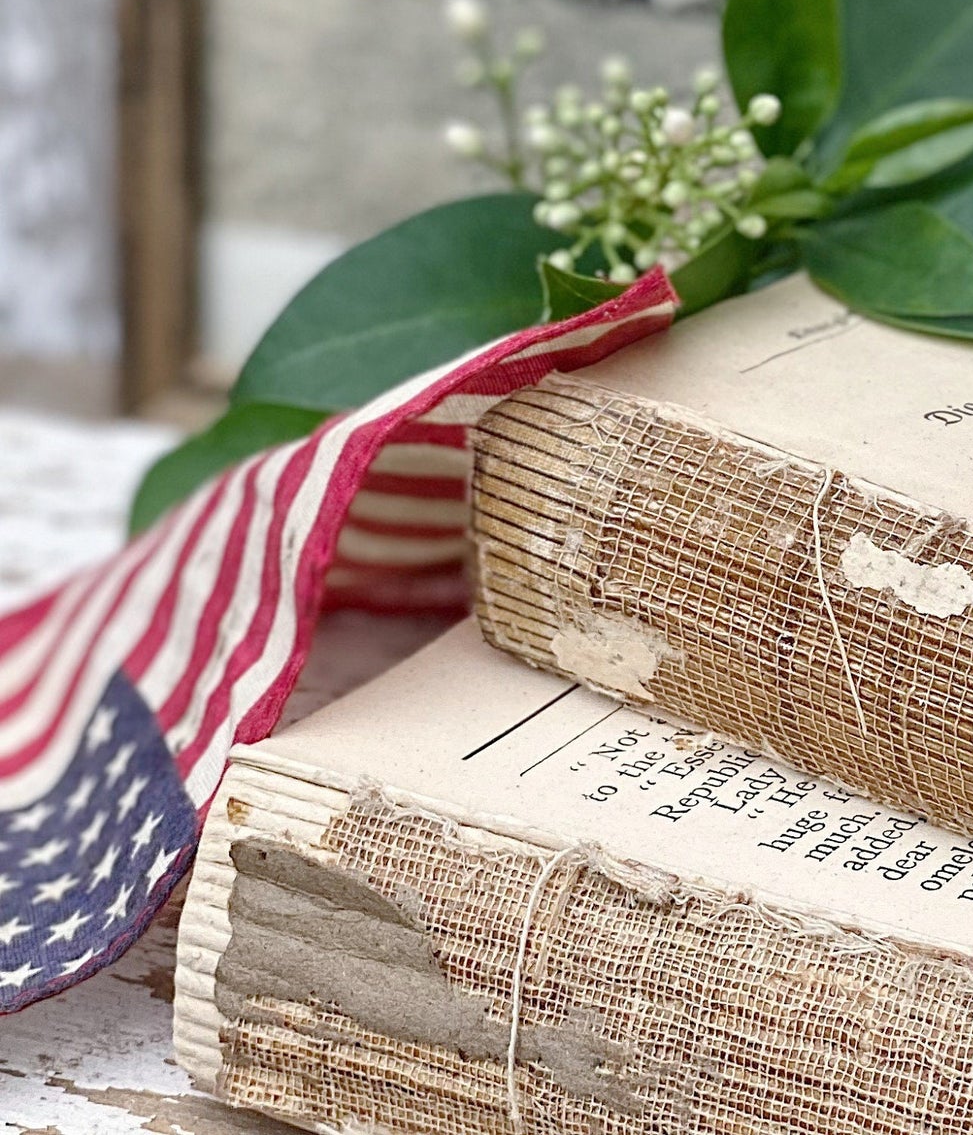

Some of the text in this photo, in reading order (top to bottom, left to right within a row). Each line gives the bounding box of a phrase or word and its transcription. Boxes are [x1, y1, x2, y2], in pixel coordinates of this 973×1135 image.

[588, 728, 650, 761] Not
[582, 750, 665, 802] to the
[710, 768, 787, 814] Lady
[766, 781, 816, 808] He
[757, 810, 828, 852] huge
[804, 811, 881, 862] much.
[843, 817, 927, 871] added,
[877, 841, 937, 881] dear
